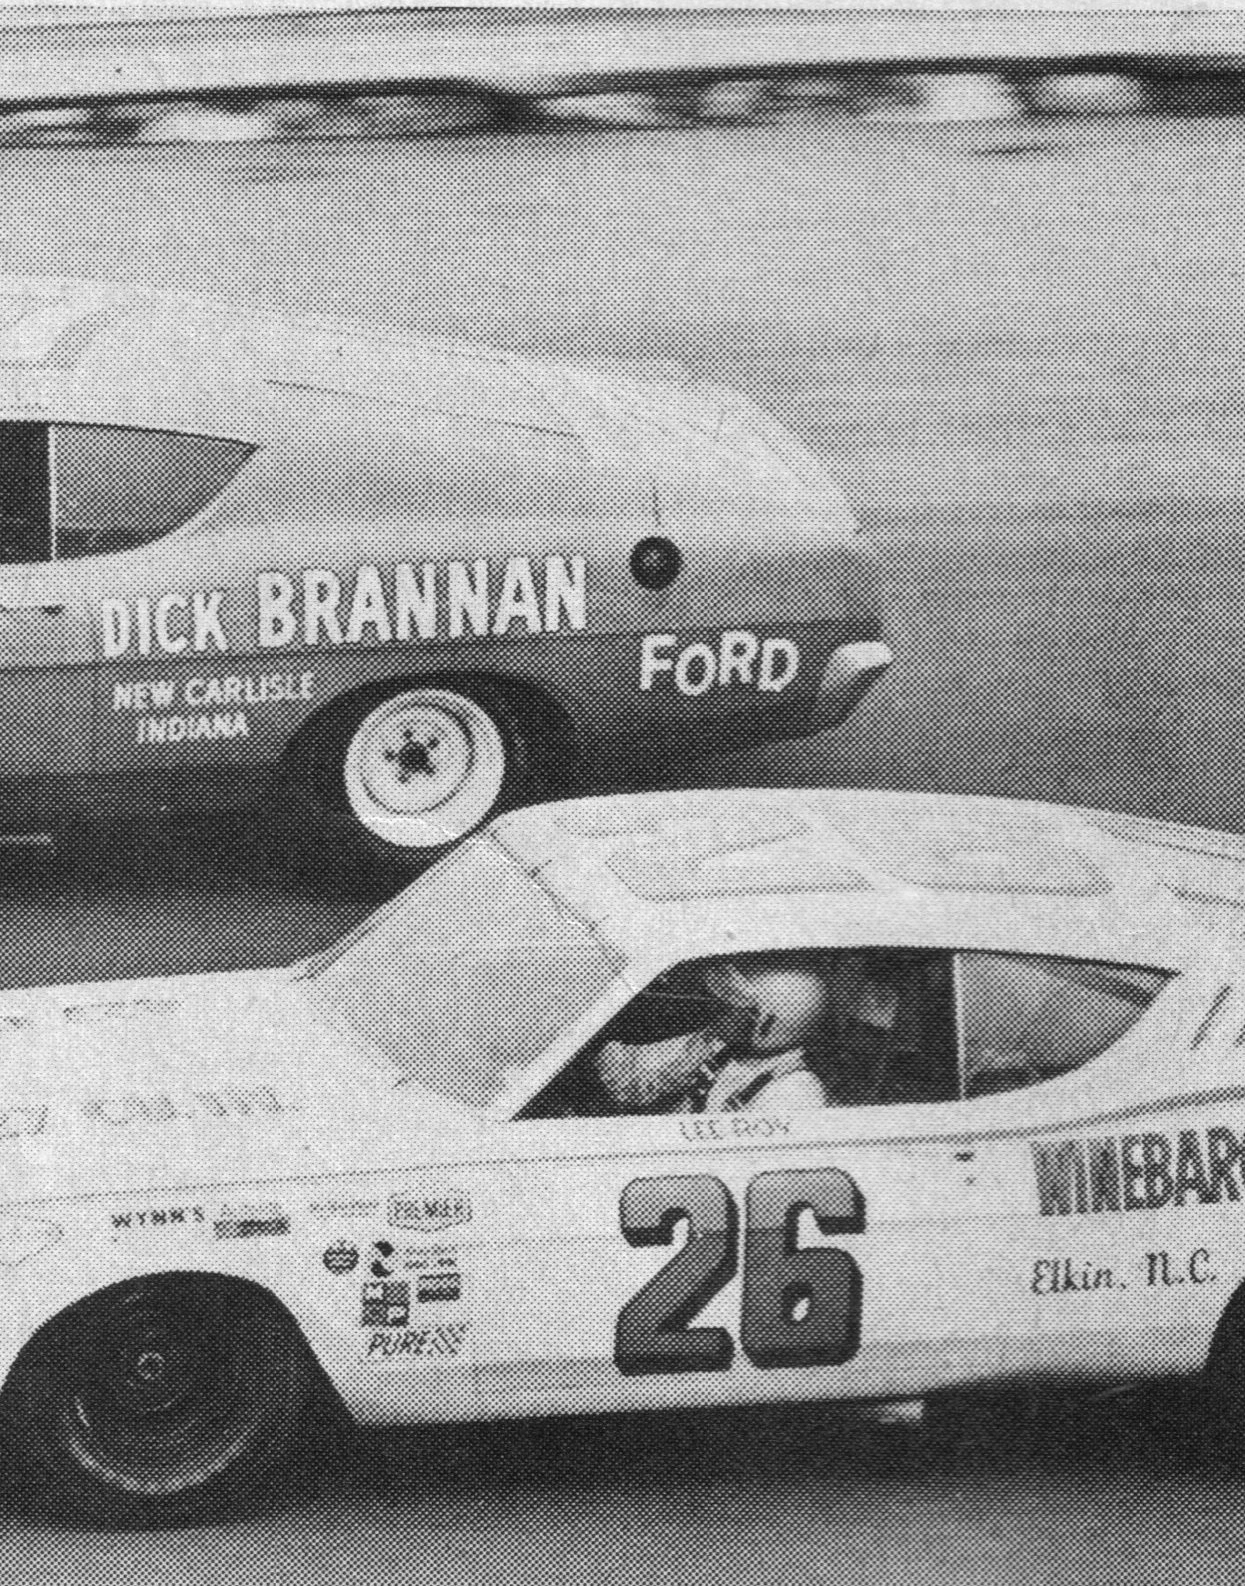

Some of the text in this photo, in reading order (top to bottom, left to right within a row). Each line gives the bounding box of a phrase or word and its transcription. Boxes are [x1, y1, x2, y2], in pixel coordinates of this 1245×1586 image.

[103, 556, 587, 658] DICK BRANNAN
[639, 630, 801, 697] FORD
[113, 671, 313, 710] NEW CARLISLE
[137, 711, 249, 744] INDIANA
[678, 1115, 792, 1142] LEE ROY
[1029, 1125, 1245, 1217] WINEBAR
[612, 1166, 866, 1378] 26
[366, 1330, 431, 1358] PURE
